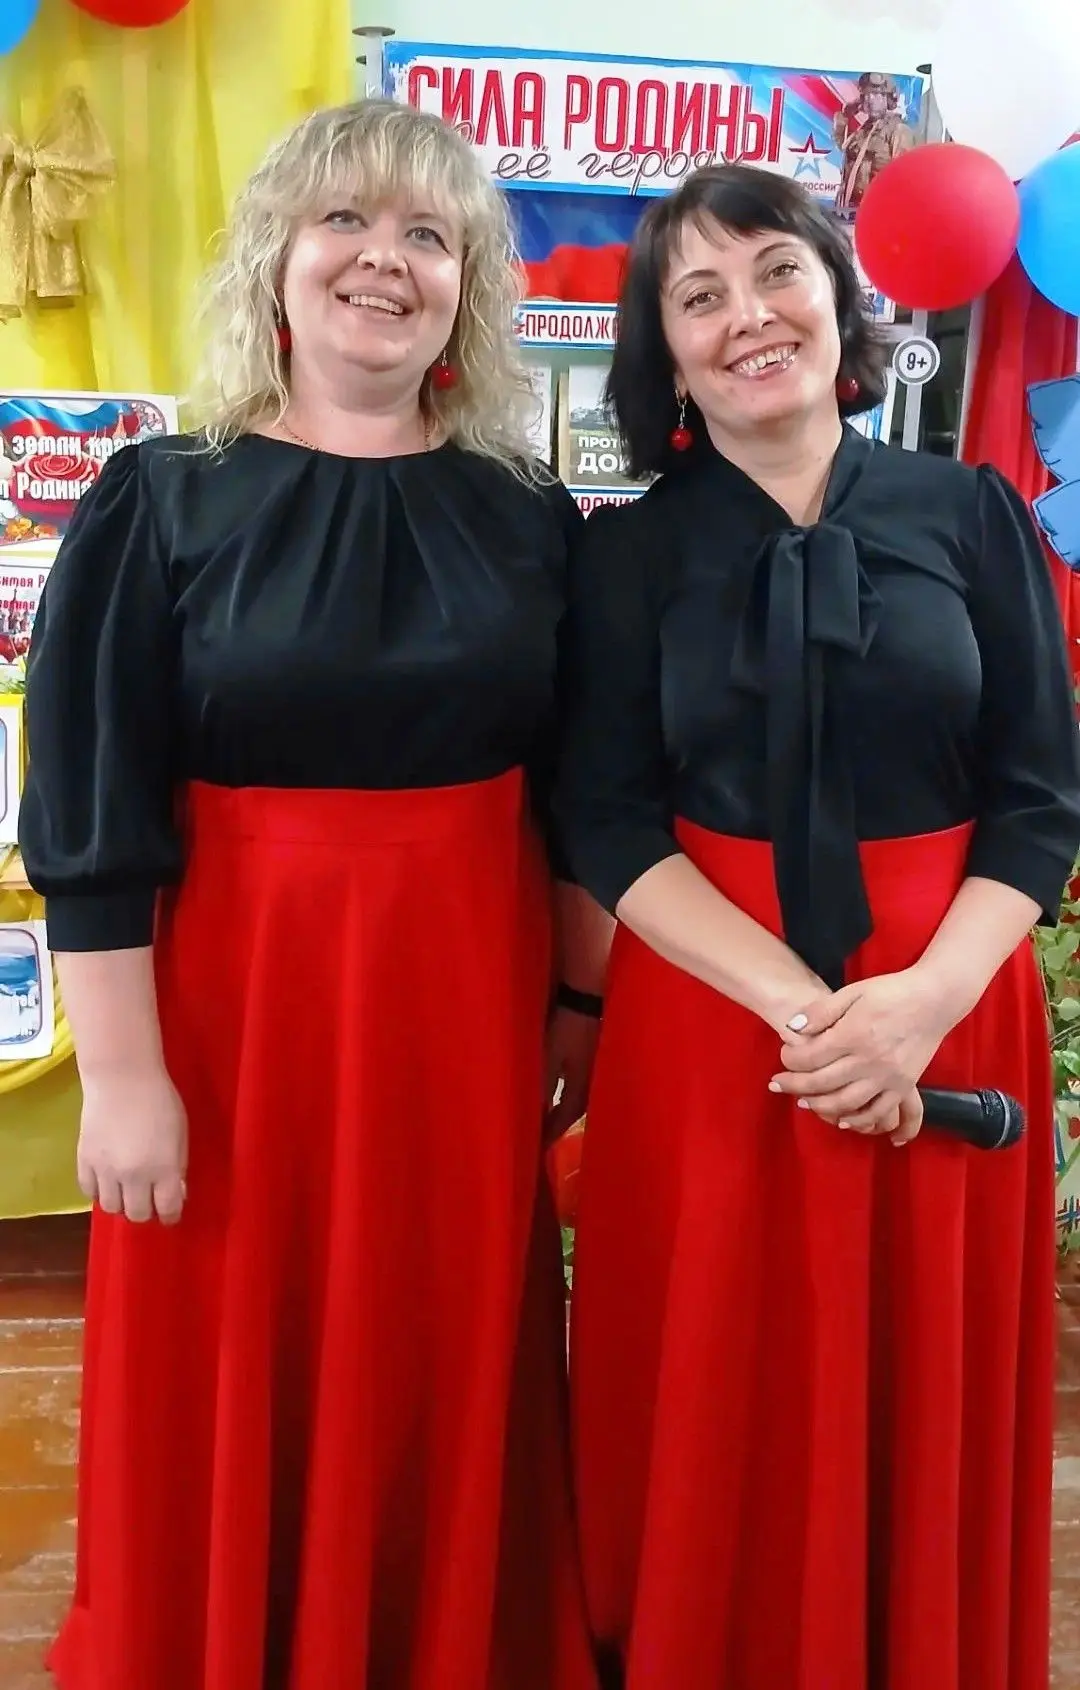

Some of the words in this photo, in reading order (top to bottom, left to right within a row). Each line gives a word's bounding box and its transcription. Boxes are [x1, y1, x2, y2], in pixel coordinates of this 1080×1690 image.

[408, 65, 546, 149] СИЛА
[564, 74, 785, 163] РОДИНЫ
[491, 146, 552, 180] её
[907, 352, 928, 370] 9+
[88, 435, 143, 460] кра
